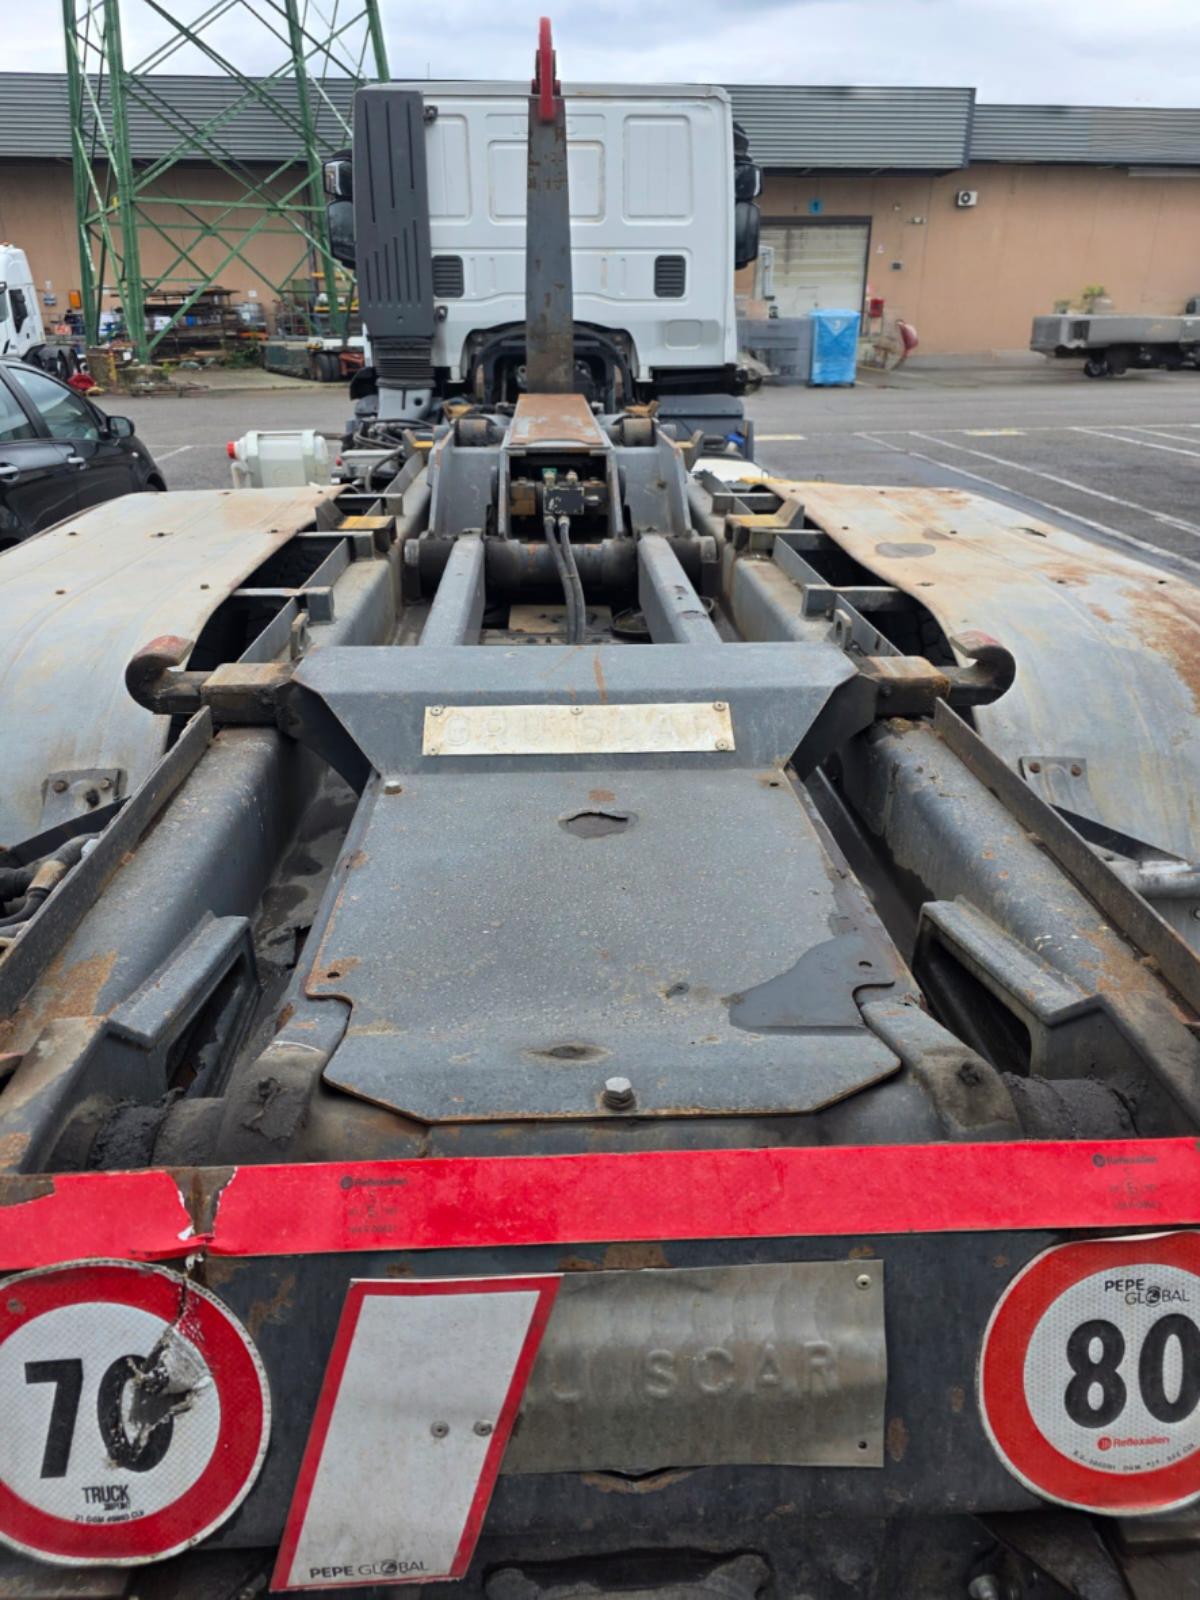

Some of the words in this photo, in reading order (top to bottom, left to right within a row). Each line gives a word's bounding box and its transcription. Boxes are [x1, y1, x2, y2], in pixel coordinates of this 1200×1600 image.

[1105, 1279, 1145, 1292] PEPE
[1125, 1286, 1190, 1307] GLOBAL
[1064, 1313, 1200, 1430] 80
[25, 1354, 174, 1479] 70
[82, 1485, 130, 1504] TRUCK
[310, 1565, 354, 1578] PEPE
[358, 1559, 429, 1576] GLOBAL
